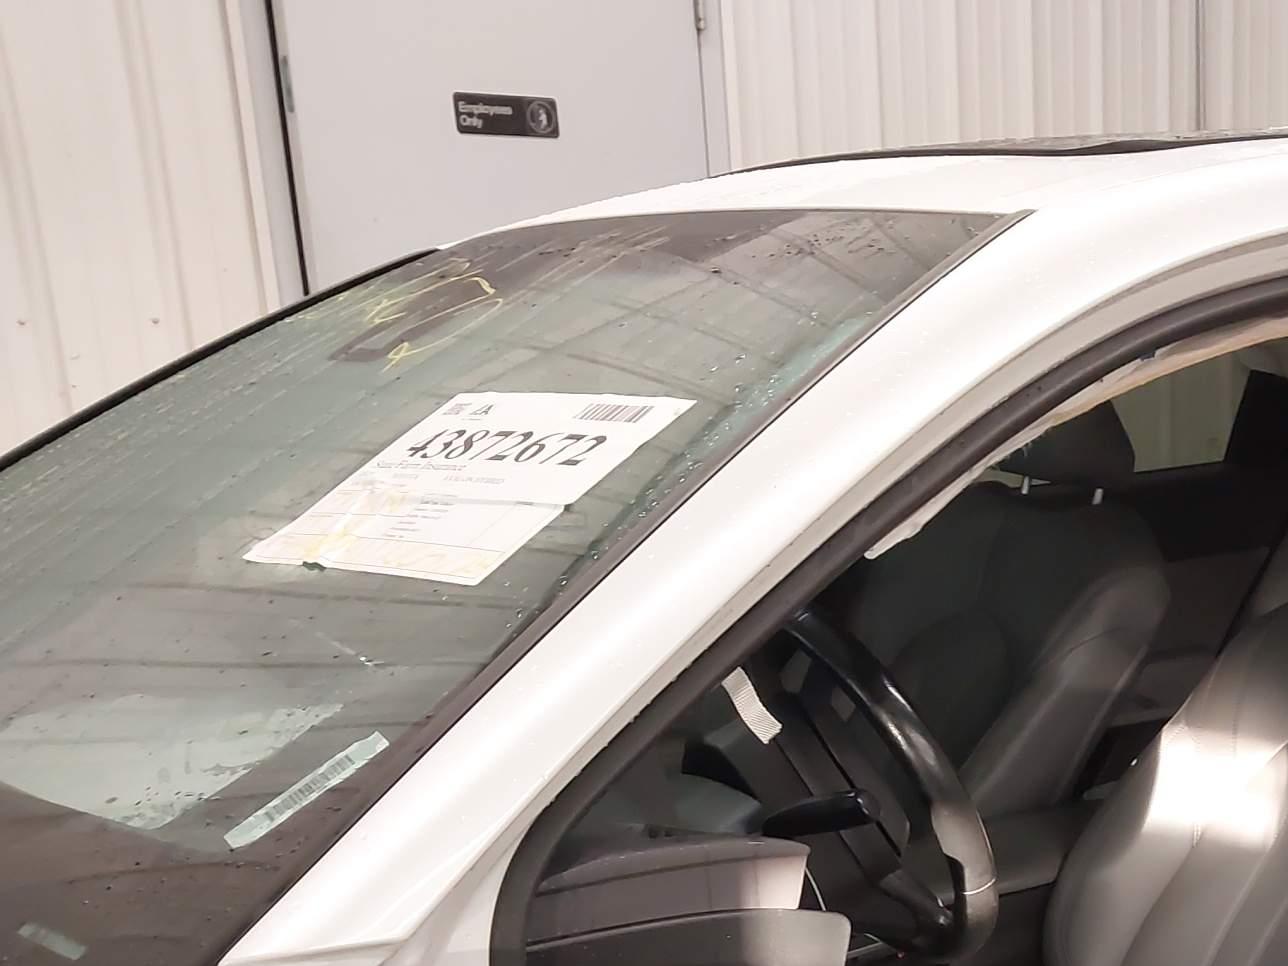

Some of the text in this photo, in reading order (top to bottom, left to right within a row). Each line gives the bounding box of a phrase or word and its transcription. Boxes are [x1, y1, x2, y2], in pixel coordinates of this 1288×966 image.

[458, 101, 513, 116] Employees
[460, 114, 483, 129] Only
[406, 428, 608, 466] 43872672
